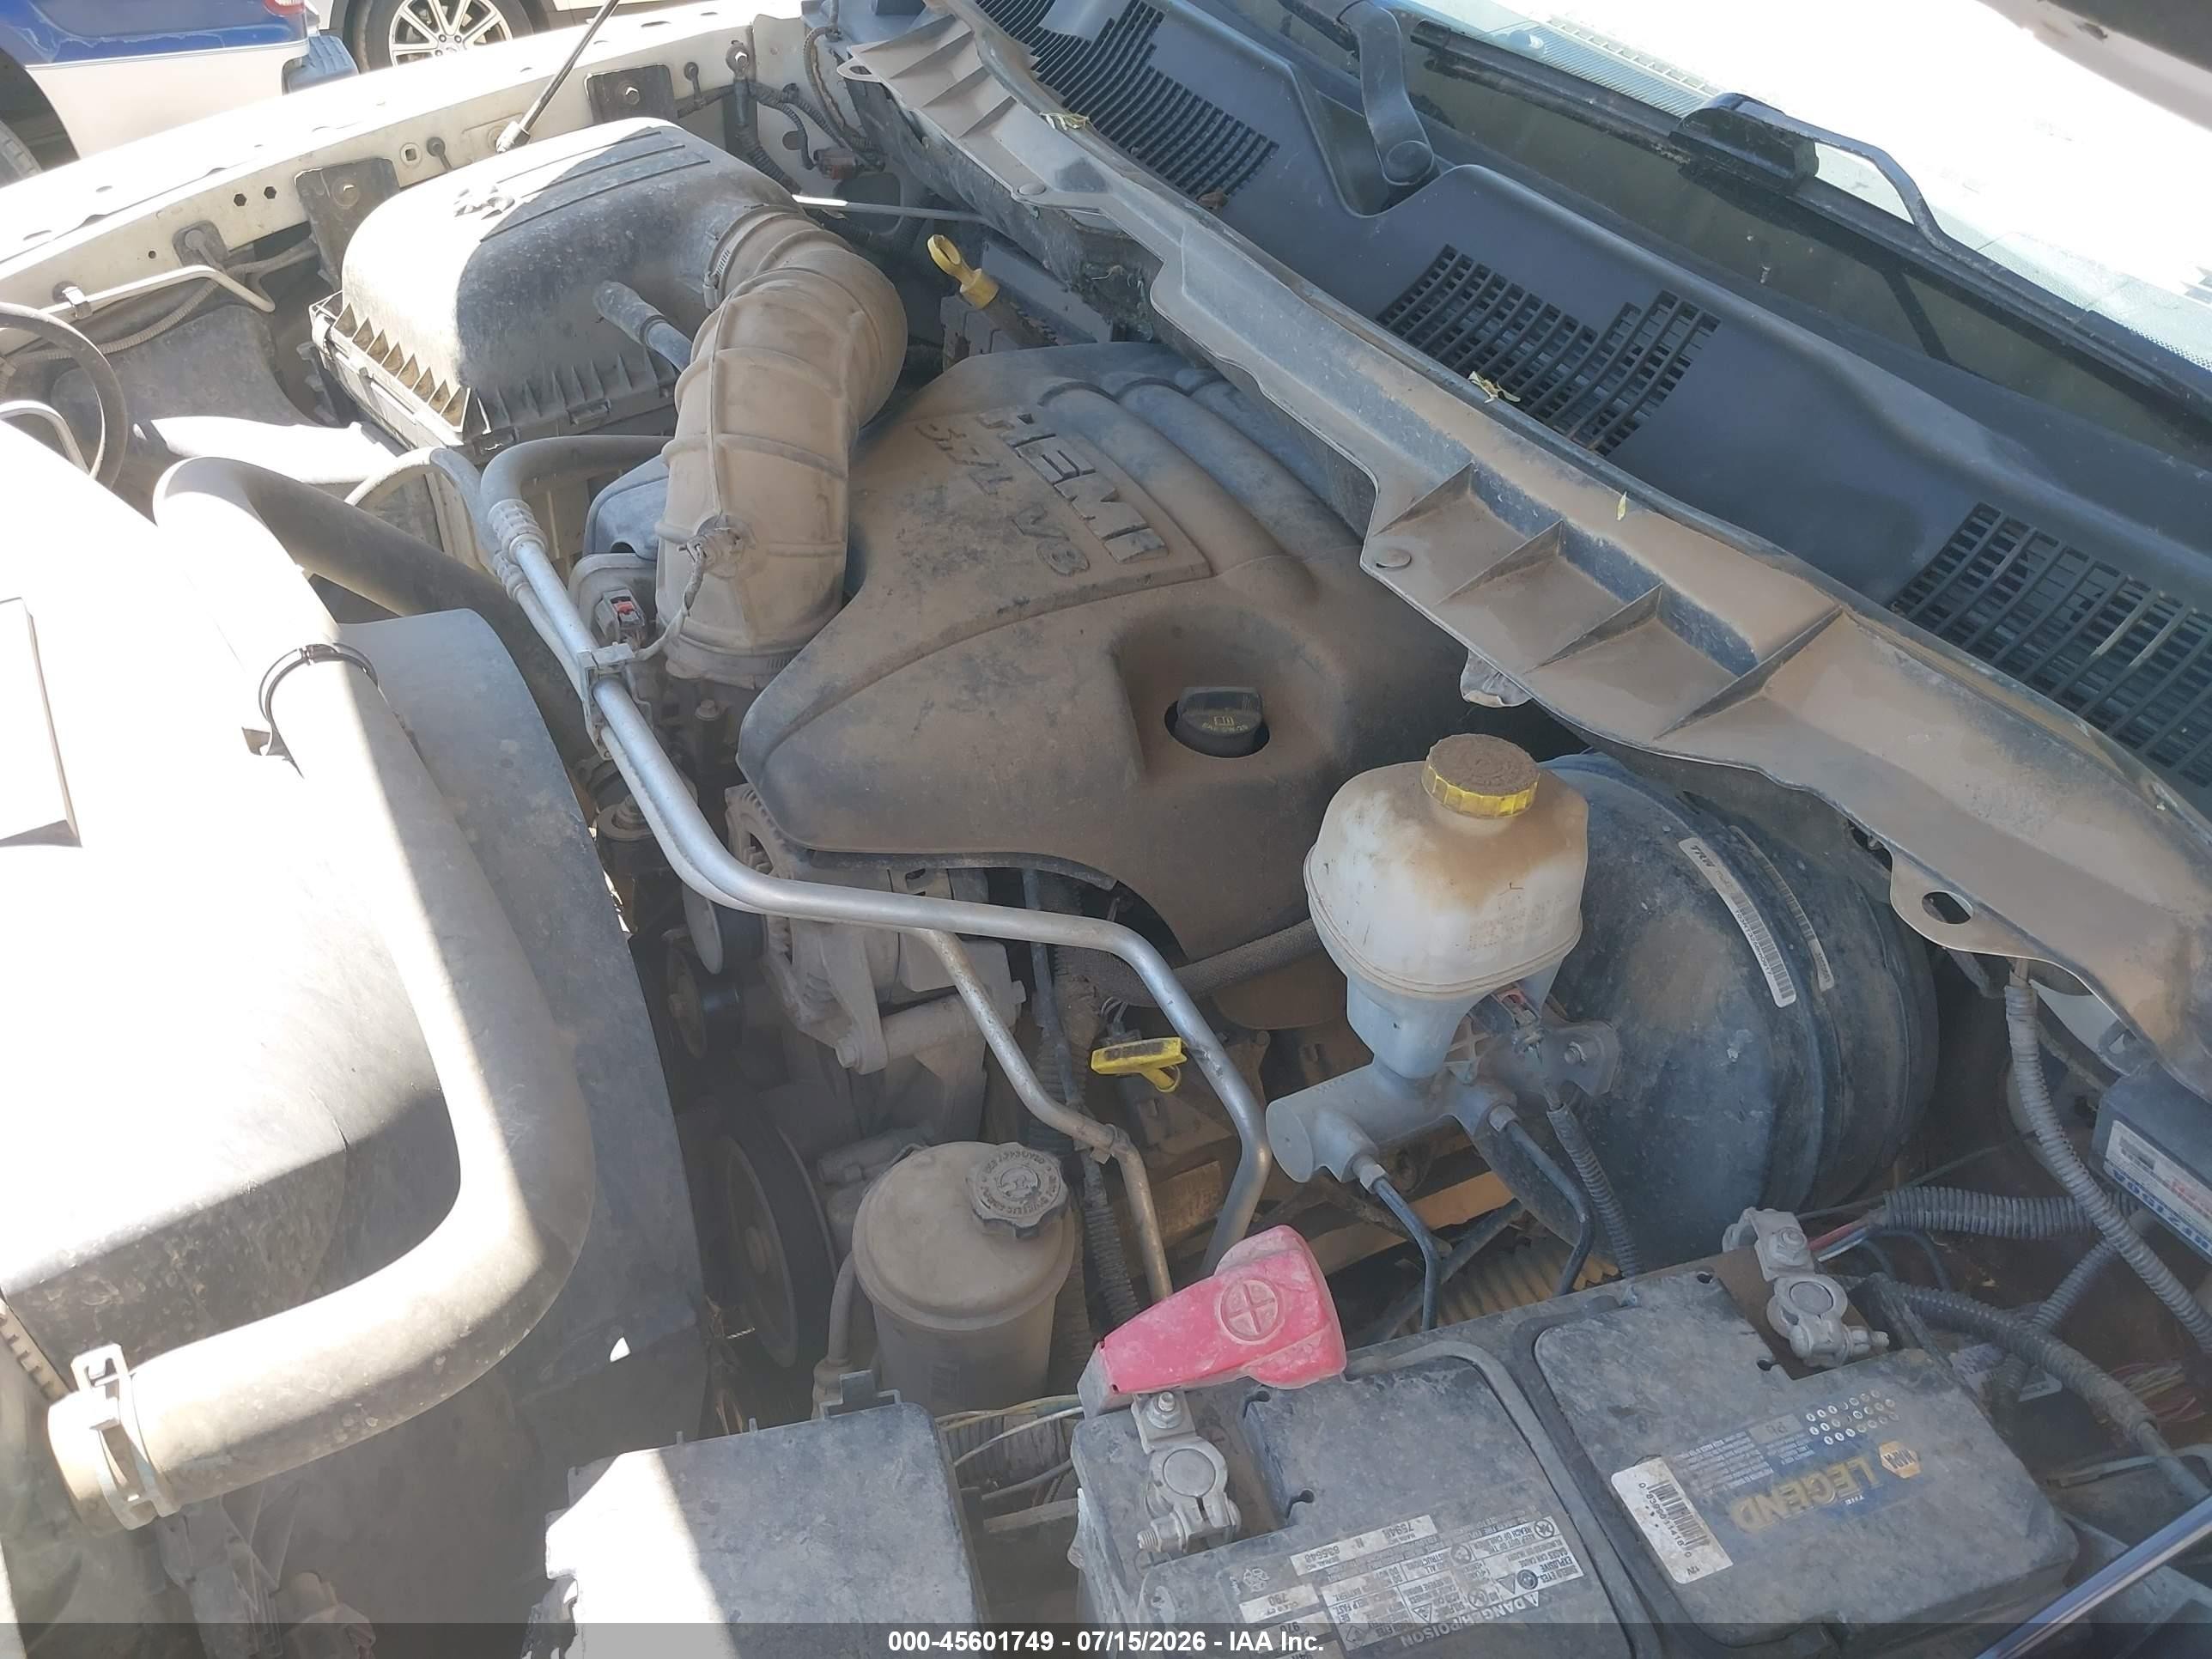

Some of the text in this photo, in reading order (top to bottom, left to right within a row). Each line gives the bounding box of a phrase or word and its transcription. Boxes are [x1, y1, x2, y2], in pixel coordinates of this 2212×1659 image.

[975, 410, 1167, 563] HEMI
[1012, 502, 1090, 576] V8
[1690, 844, 1715, 867] TRW
[1729, 1455, 1880, 1533] LEGEND
[1844, 1494, 1863, 1504] THE
[1539, 1555, 1572, 1573] EXPLOSIVE
[1267, 1592, 1289, 1607] 790
